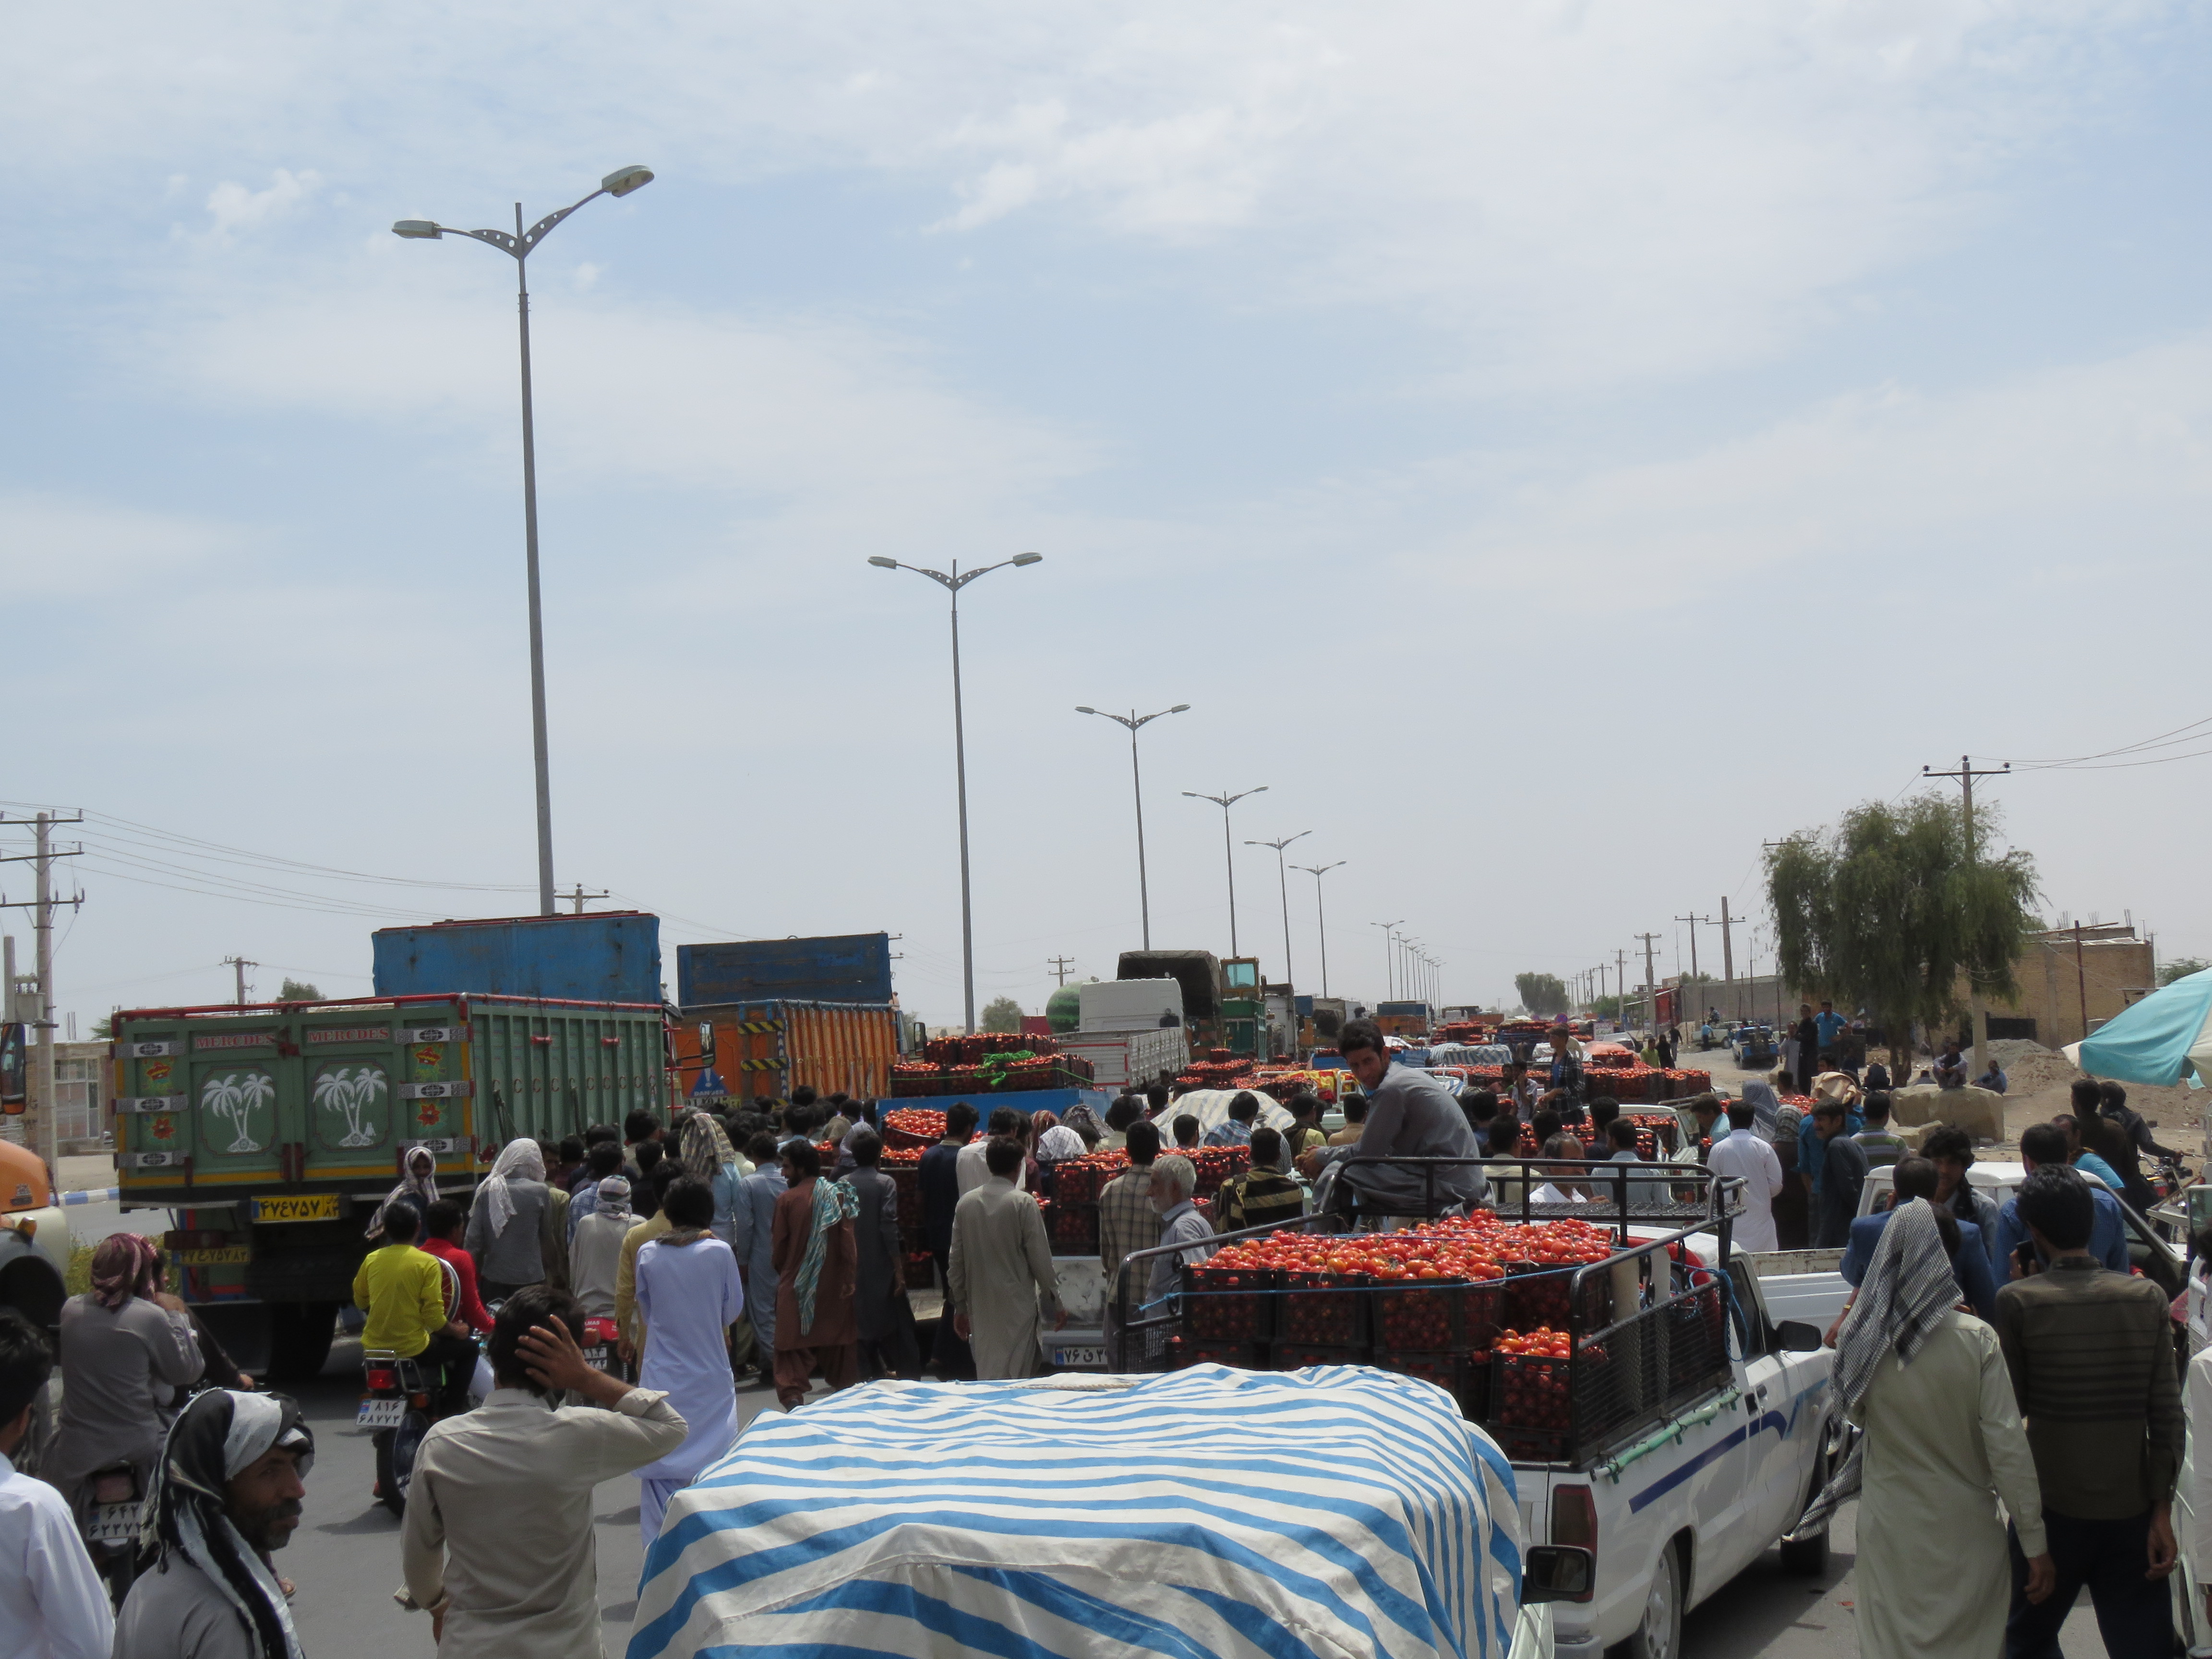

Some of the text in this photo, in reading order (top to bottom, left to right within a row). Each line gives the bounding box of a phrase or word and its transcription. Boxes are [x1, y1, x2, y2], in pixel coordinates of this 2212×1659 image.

[195, 1033, 275, 1049] MERCDES
[308, 1028, 390, 1043] MERCDES
[1065, 1349, 1080, 1363] ۷۶
[1083, 1349, 1094, 1362] ق
[375, 1402, 399, 1411] ۸۱۶
